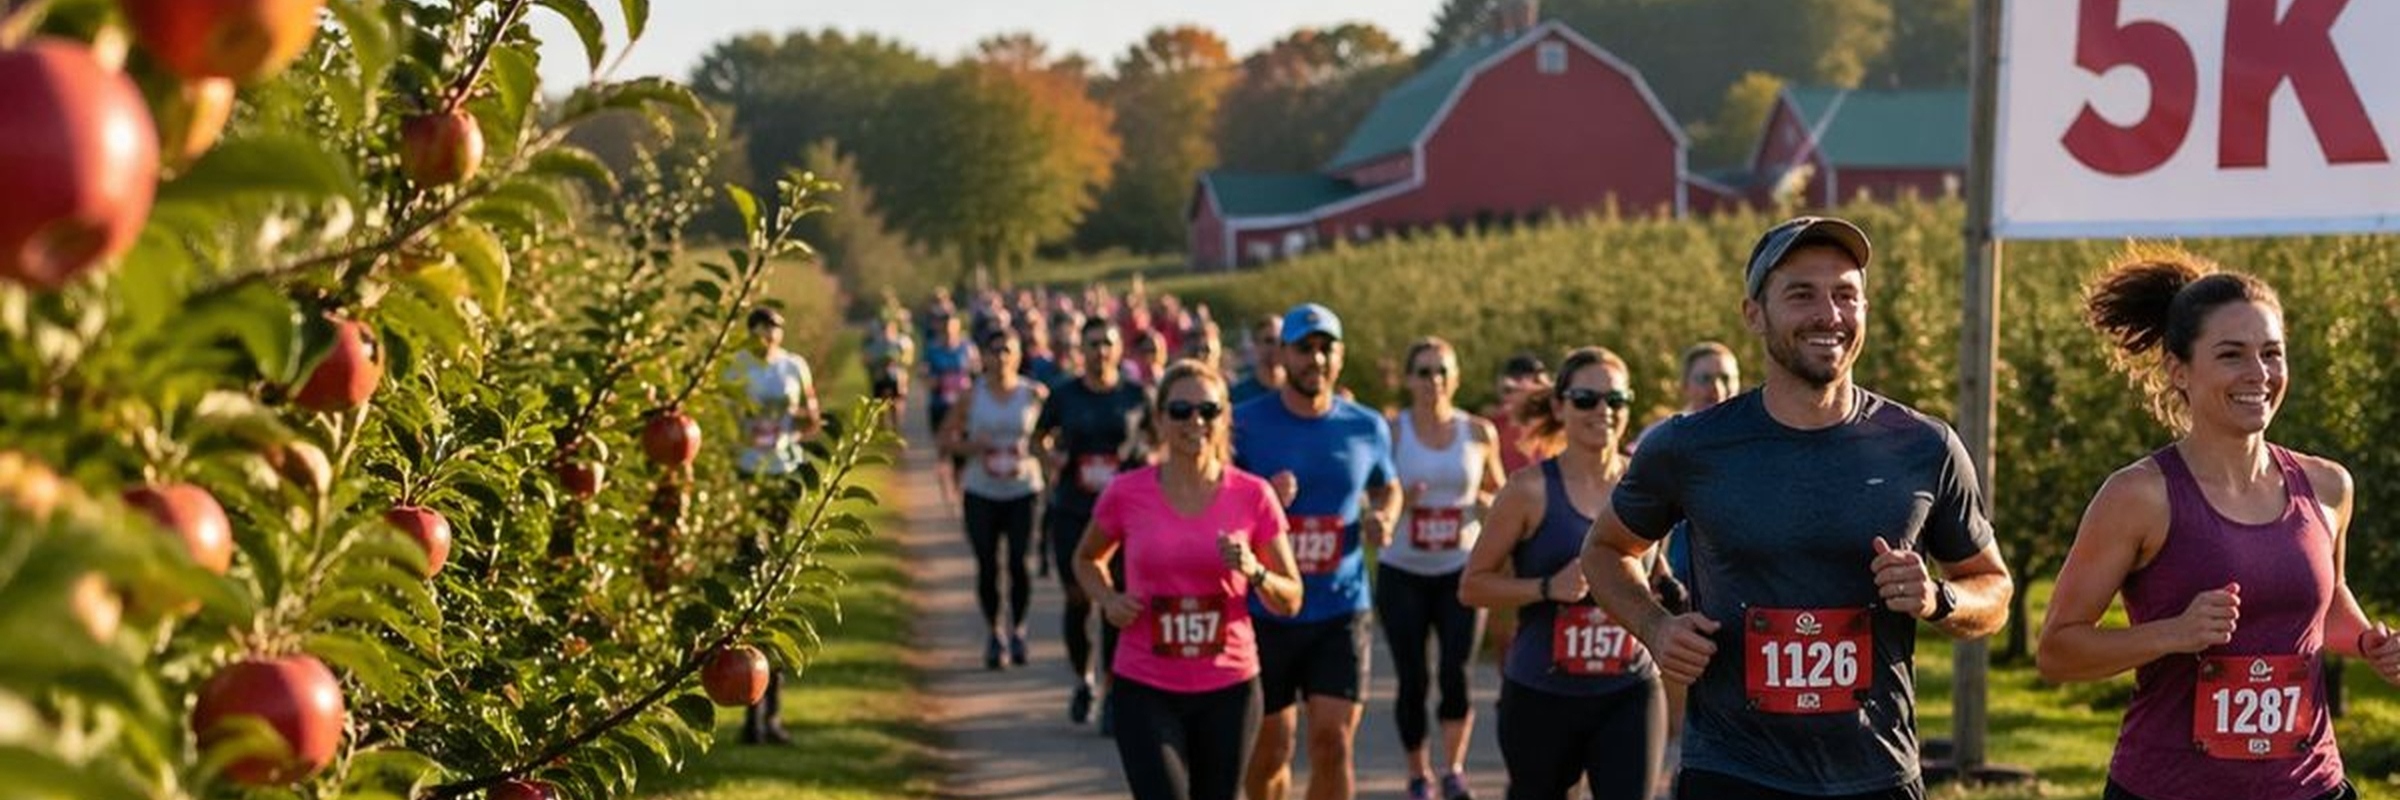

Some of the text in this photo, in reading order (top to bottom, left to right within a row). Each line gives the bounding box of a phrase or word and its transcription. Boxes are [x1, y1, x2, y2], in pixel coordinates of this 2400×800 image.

[2060, 0, 2390, 177] 5K
[1161, 611, 1219, 643] 1157
[1565, 626, 1627, 657] 1157
[1761, 641, 1858, 687] 1126
[2212, 686, 2300, 733] 1287
